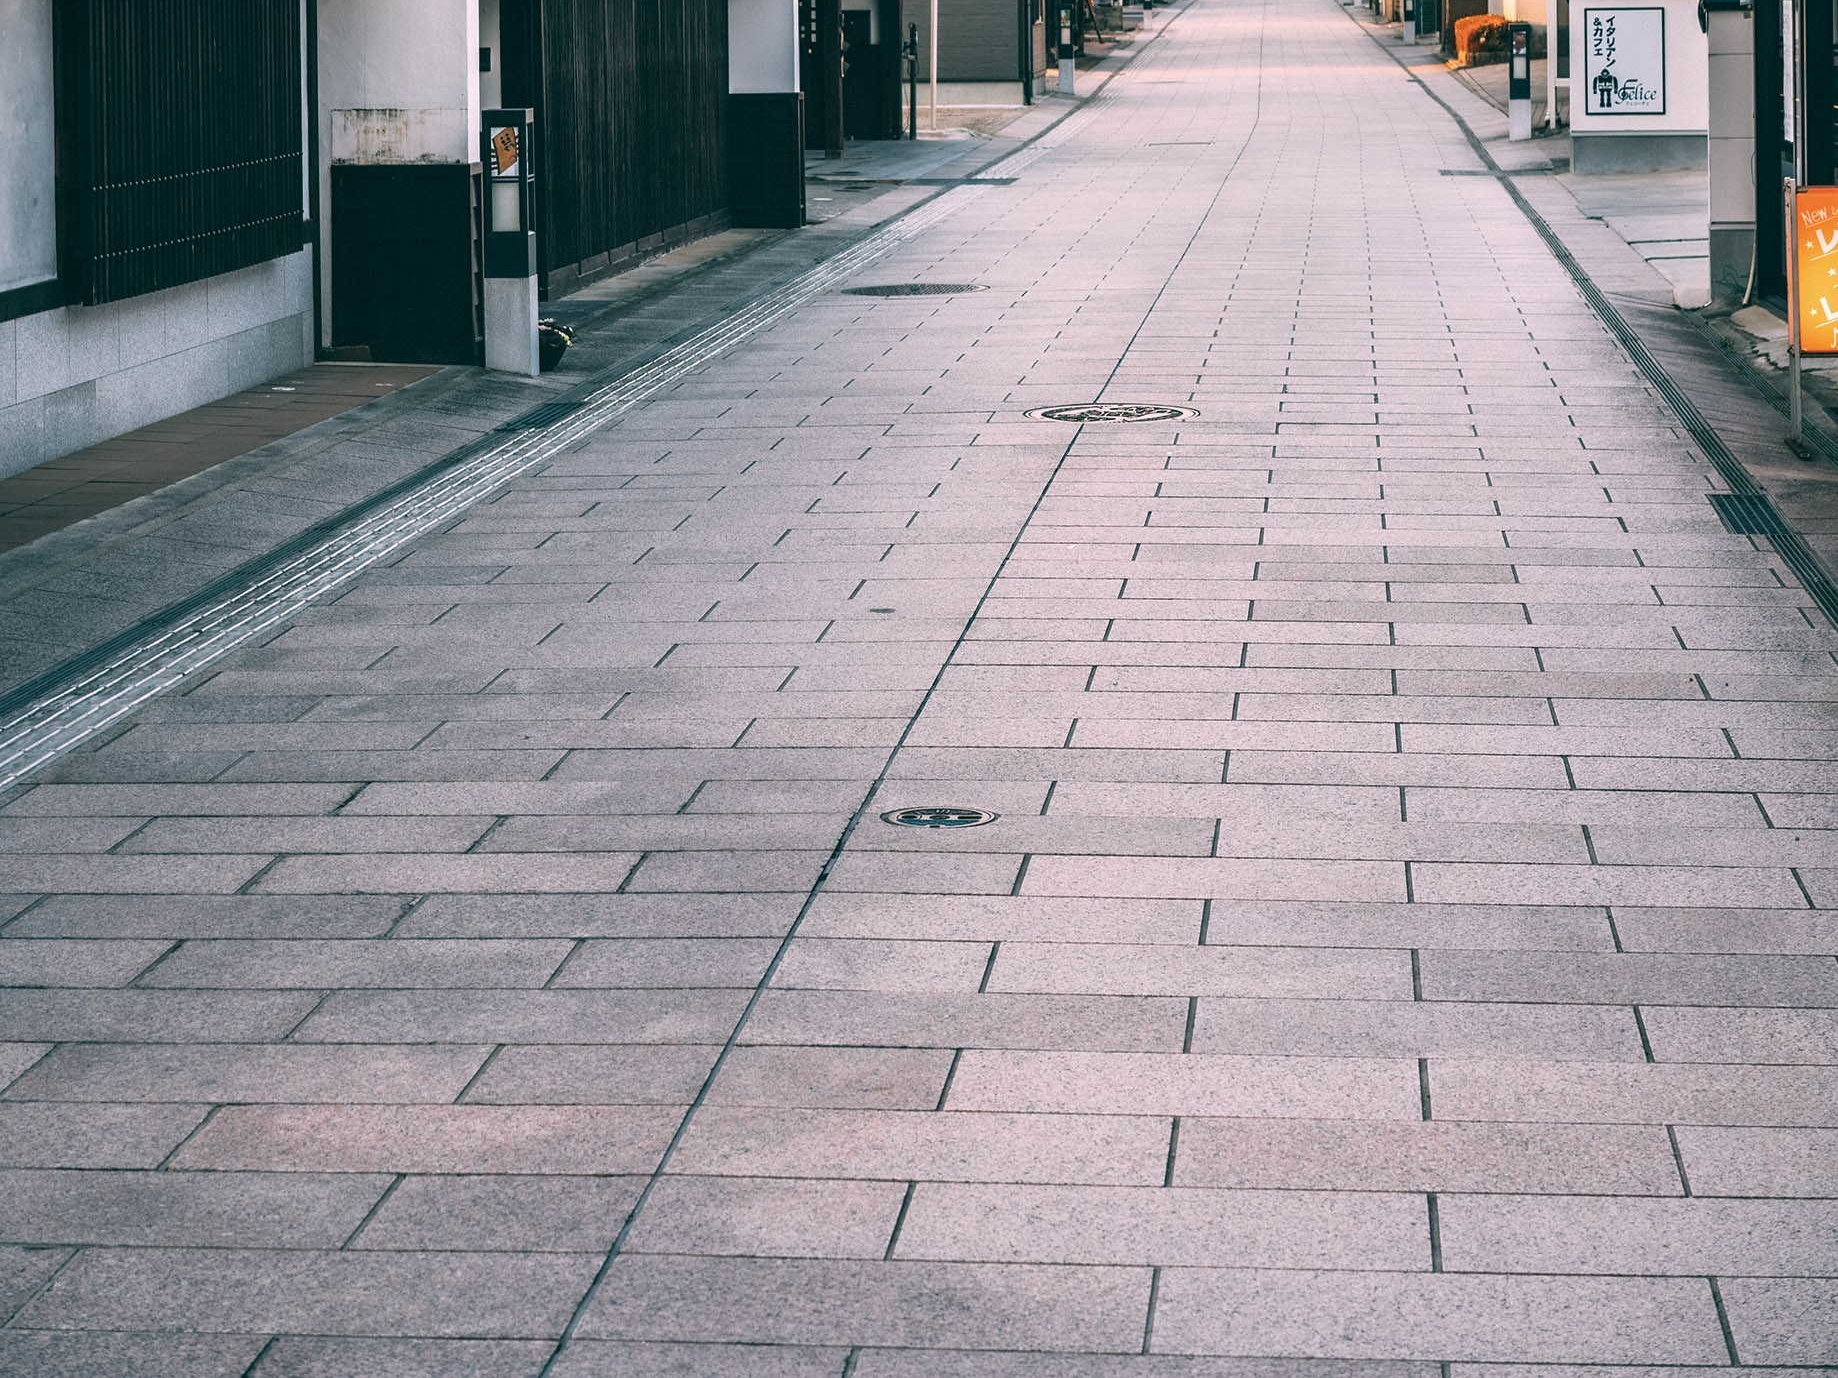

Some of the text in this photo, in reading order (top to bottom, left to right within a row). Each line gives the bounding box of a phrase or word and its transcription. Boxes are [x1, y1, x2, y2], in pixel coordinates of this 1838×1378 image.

[1593, 17, 1603, 56] &カフェ
[1605, 15, 1616, 68] イタリアン
[1615, 78, 1657, 105] Felice
[1801, 206, 1828, 226] New
